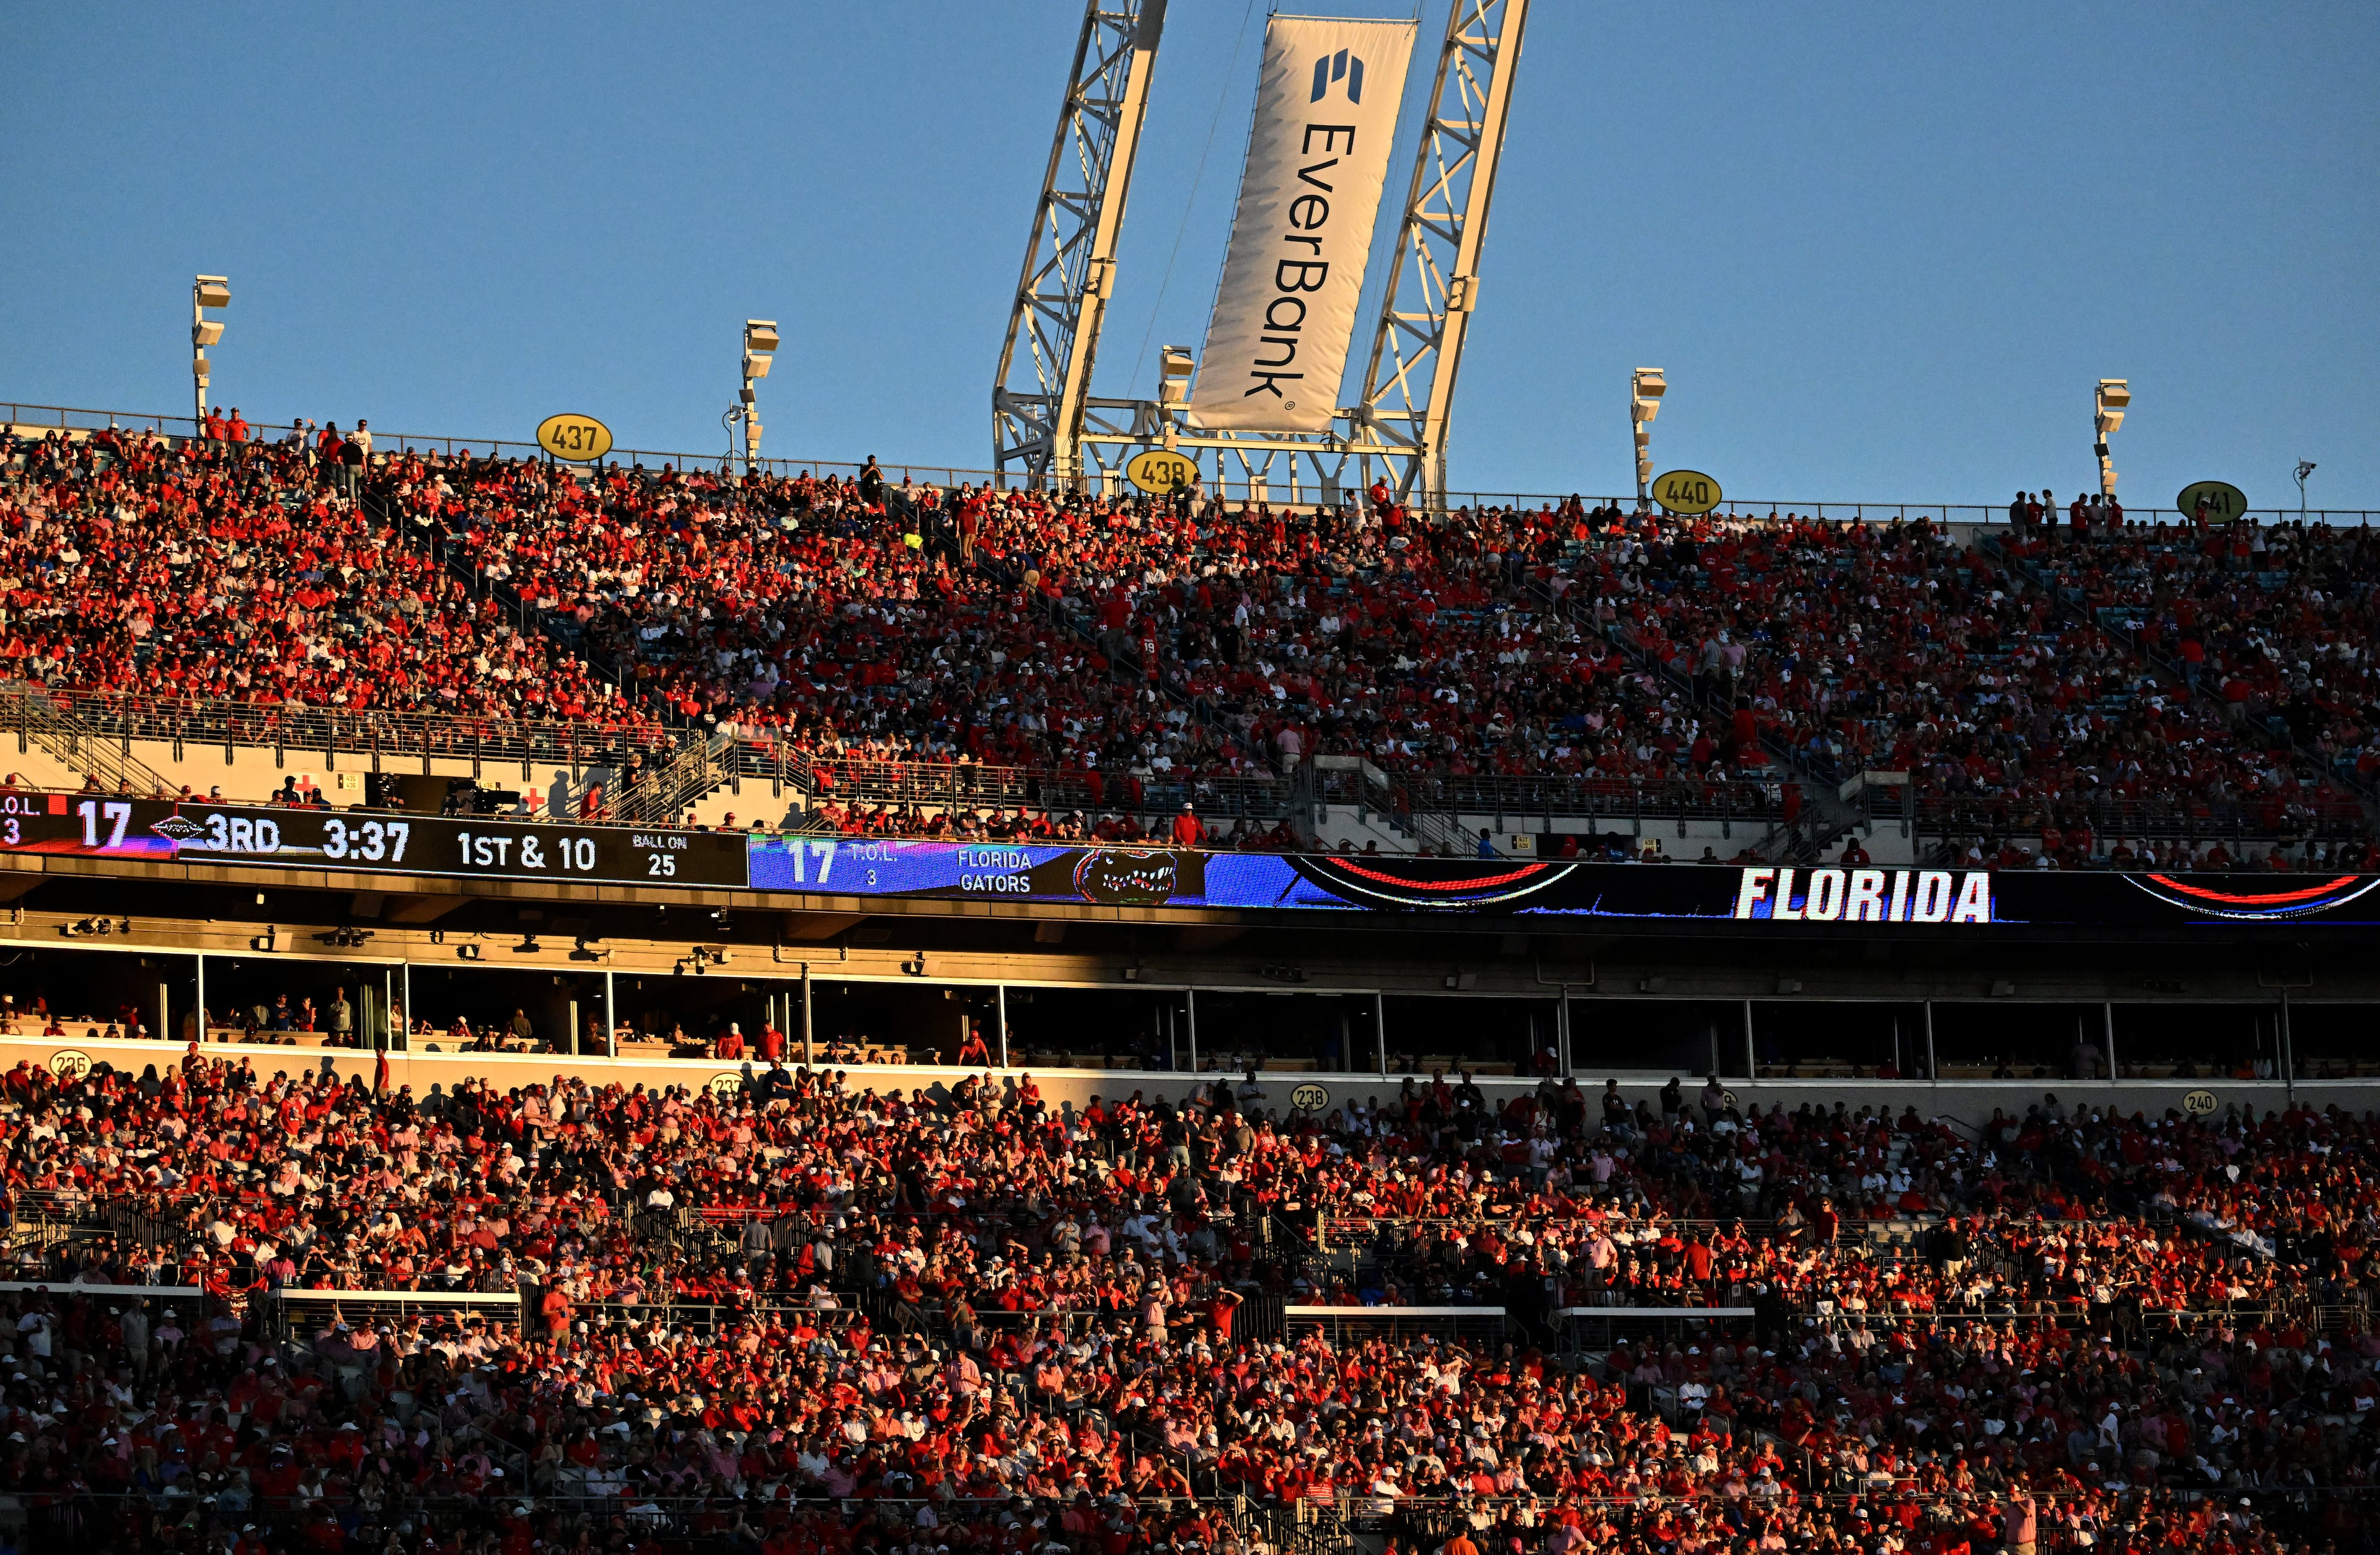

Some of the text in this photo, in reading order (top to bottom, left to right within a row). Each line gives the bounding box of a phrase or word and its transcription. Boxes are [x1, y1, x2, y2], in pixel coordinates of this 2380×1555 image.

[1244, 124, 1356, 399] EverBank
[551, 425, 597, 451] 437
[1140, 462, 1185, 486] 438
[1381, 489, 1386, 498] 3
[1665, 480, 1708, 504] 440
[1011, 596, 1023, 607] 93
[1124, 591, 1132, 602] 19
[1144, 641, 1155, 653] 19
[3, 817, 20, 845] 3
[77, 801, 131, 847] 17
[205, 813, 280, 853] 3RD
[321, 819, 409, 862] 3:37
[457, 832, 596, 871] 1ST & 10
[788, 839, 835, 884] 17
[958, 850, 1033, 870] FLORIDA
[648, 853, 676, 876] 25
[866, 869, 876, 886] 3
[961, 874, 1030, 893] GATORS
[1735, 867, 1991, 923] FLORIDA
[1297, 1090, 1323, 1105] 238
[2188, 1095, 2213, 1110] 240
[1176, 1240, 1183, 1253] 3
[897, 1306, 908, 1323] 136
[1549, 1313, 1560, 1329] 138
